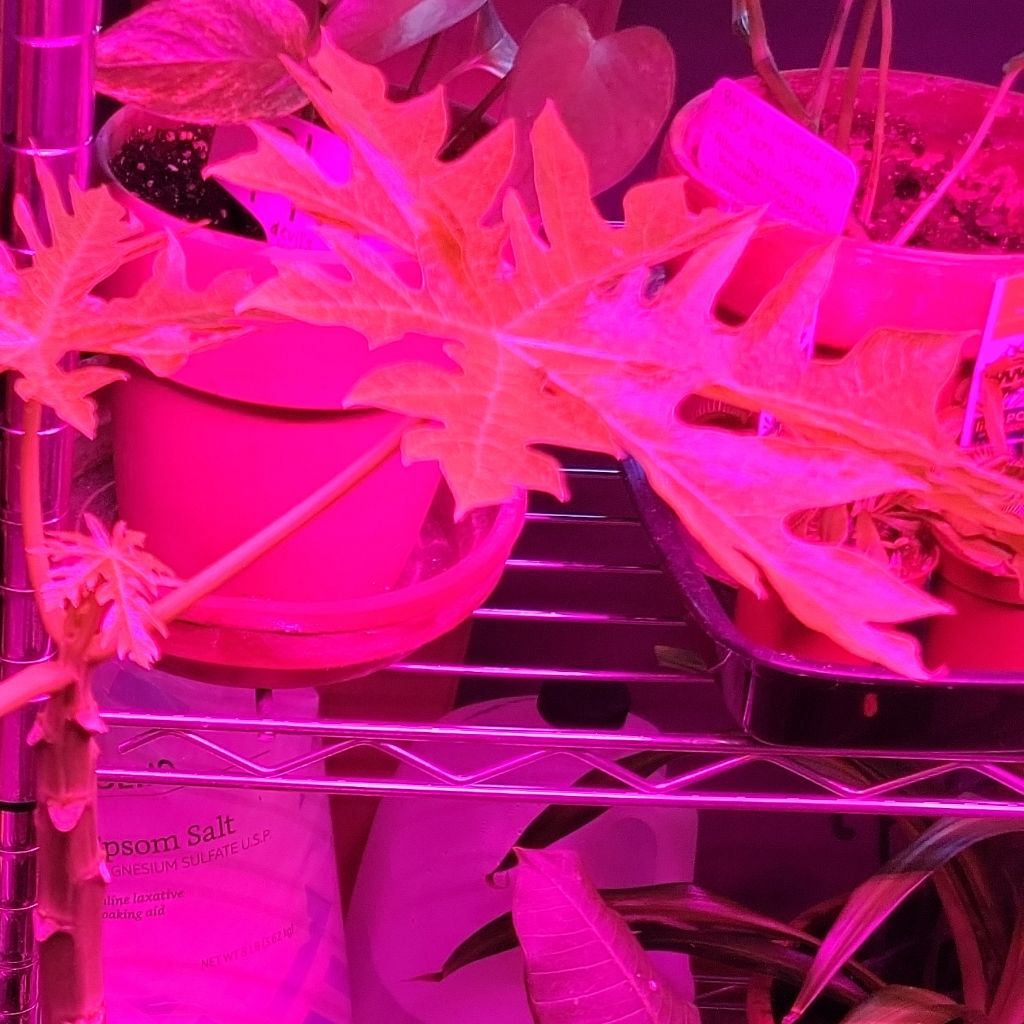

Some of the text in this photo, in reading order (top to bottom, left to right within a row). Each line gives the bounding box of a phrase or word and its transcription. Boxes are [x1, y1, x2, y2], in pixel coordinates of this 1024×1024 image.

[98, 815, 236, 863] psom Salt
[109, 860, 178, 877] GNESIUM
[182, 842, 238, 869] SULFATE
[133, 888, 184, 904] laxative
[103, 904, 165, 921] oaking aid
[201, 953, 221, 969] NET
